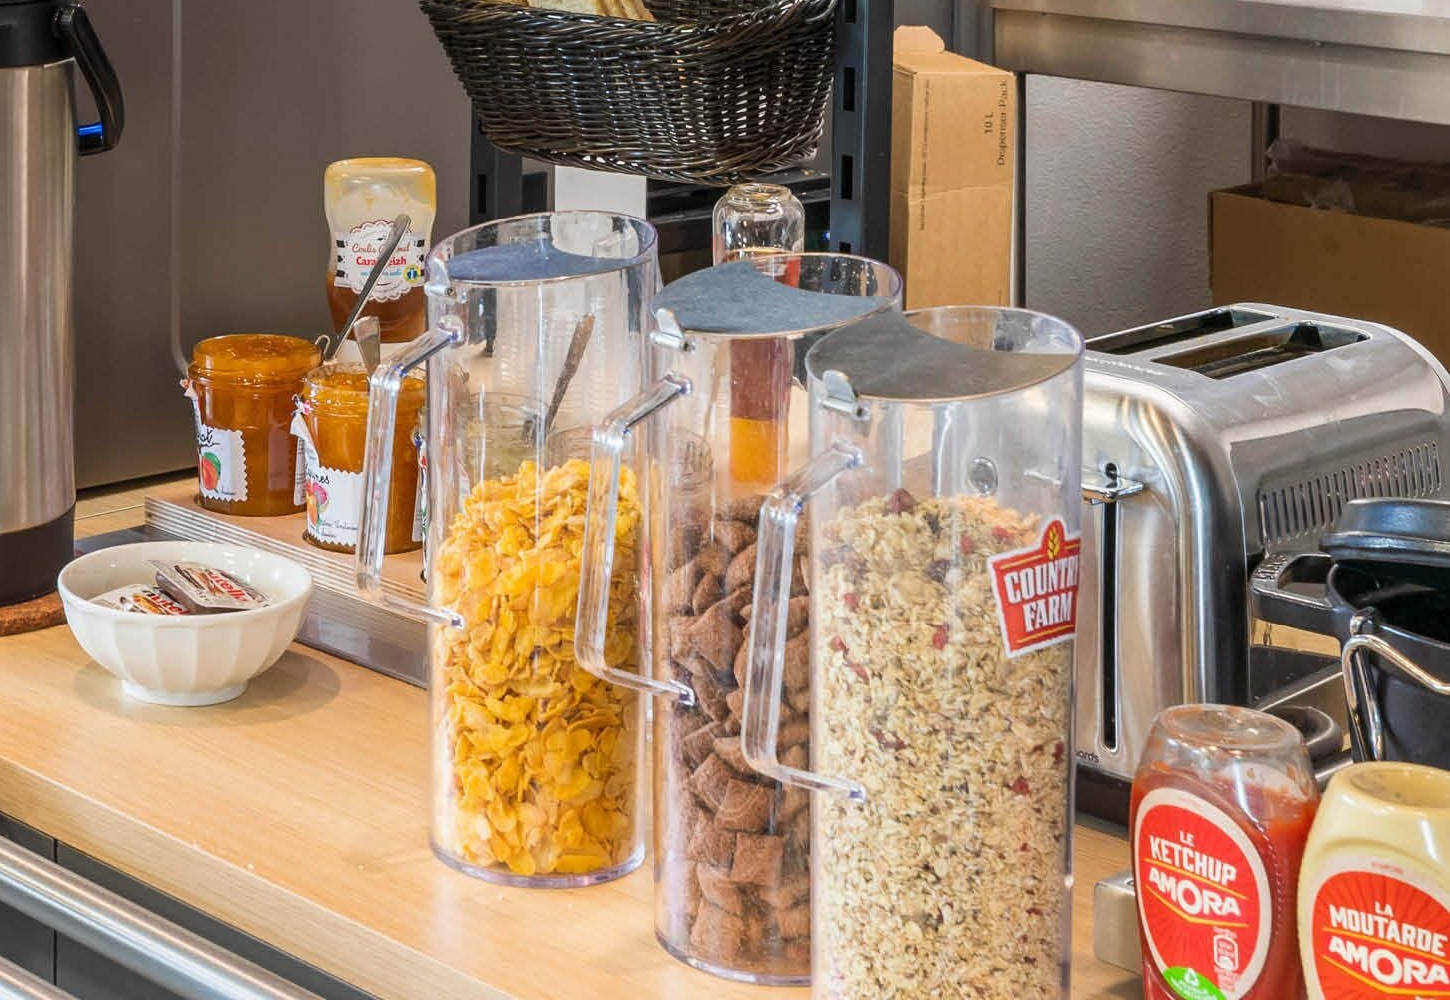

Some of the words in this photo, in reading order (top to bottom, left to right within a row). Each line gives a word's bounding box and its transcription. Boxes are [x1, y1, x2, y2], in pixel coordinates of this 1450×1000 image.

[997, 79, 1008, 108] Pack
[984, 121, 994, 134] 10
[996, 112, 1008, 166] Dispenser
[1022, 591, 1073, 633] FARM
[1149, 834, 1238, 886] KETCHUP
[1179, 830, 1195, 847] LE
[1149, 866, 1242, 917] AMORA
[1374, 900, 1394, 918] LA
[1328, 903, 1449, 957] MOUTARDE
[1328, 935, 1450, 985] AMORA
